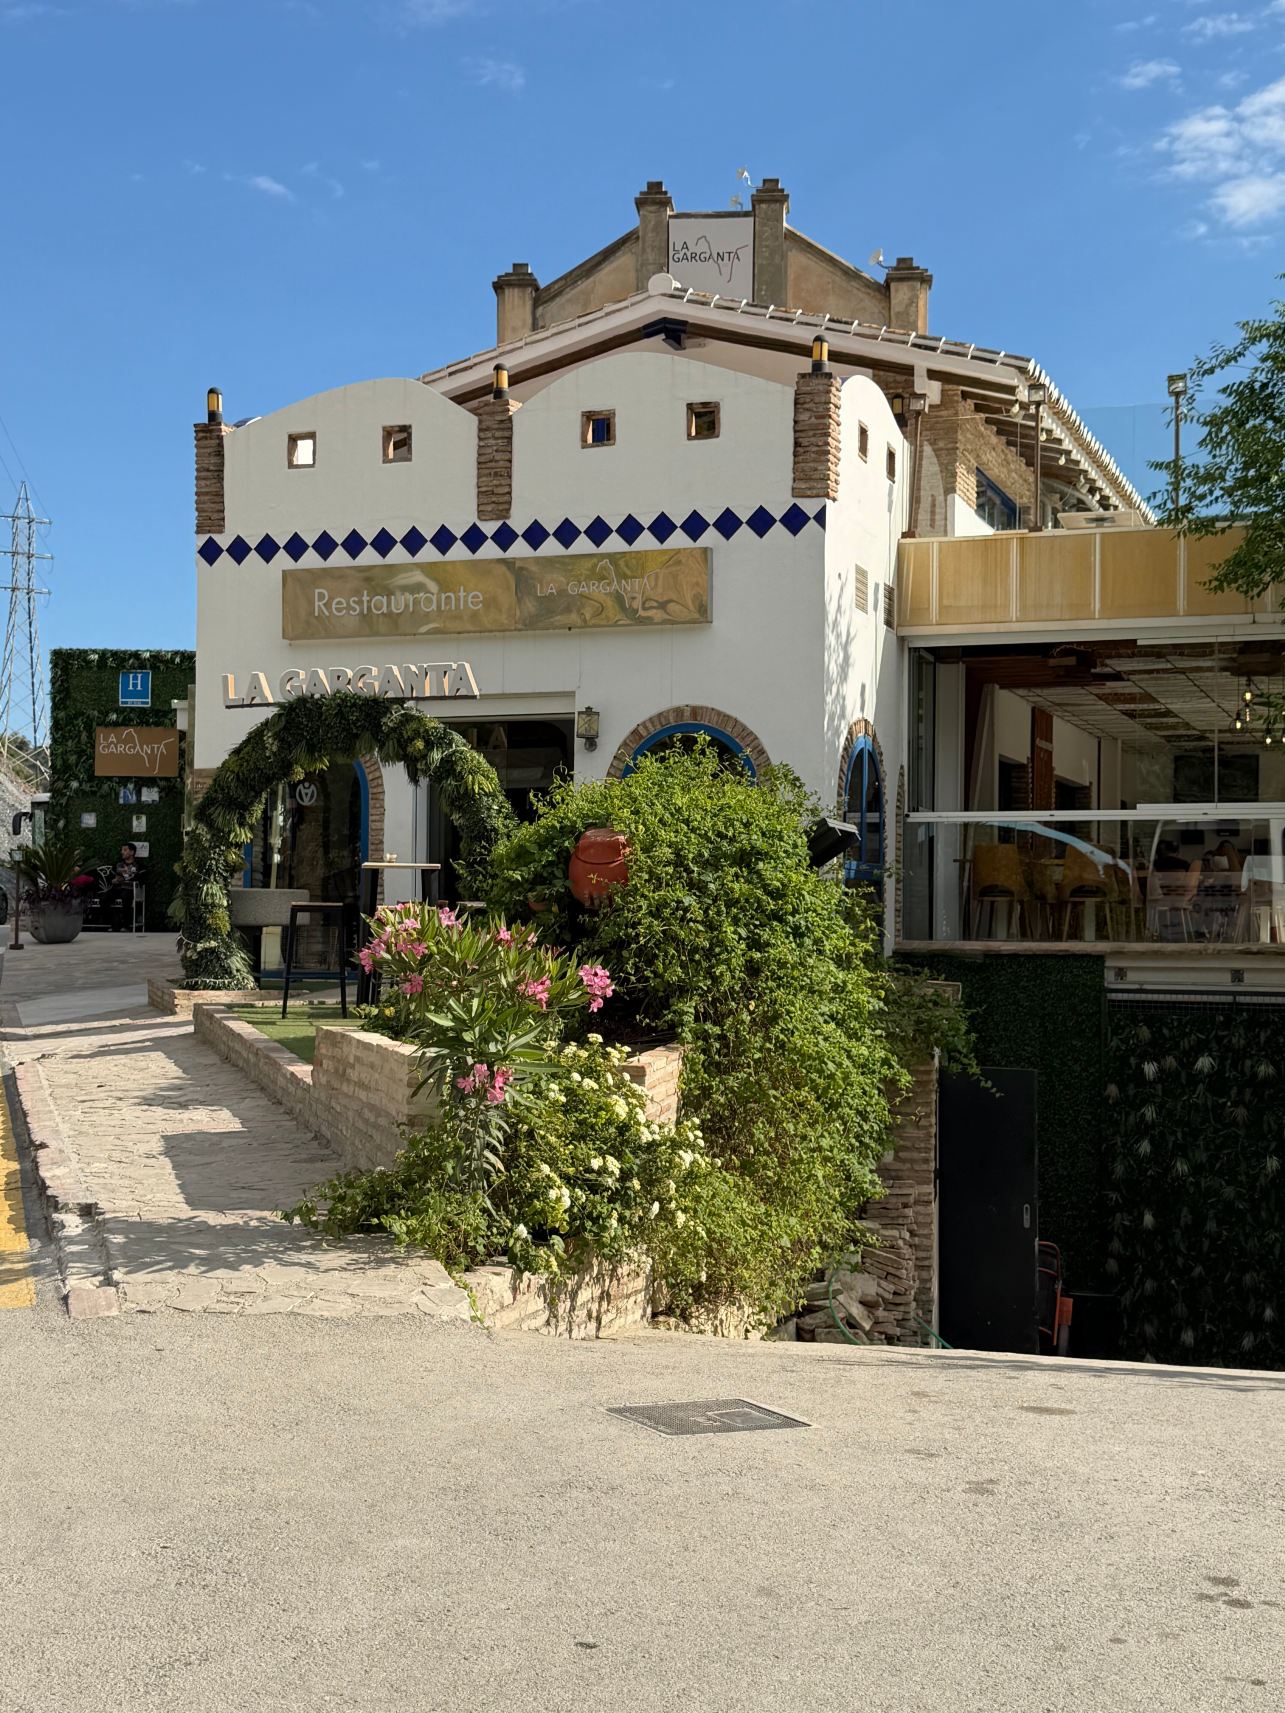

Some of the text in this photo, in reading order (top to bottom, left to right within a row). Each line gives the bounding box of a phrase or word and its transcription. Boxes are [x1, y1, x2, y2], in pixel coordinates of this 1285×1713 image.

[672, 241, 690, 252] LA
[672, 251, 741, 263] GARGANTA
[537, 578, 653, 597] LA GARGANTA
[314, 586, 483, 616] Restaurante
[128, 673, 143, 690] H
[221, 661, 480, 706] LA GARGANTA
[100, 733, 117, 744] LA
[99, 743, 167, 755] GARGANTA
